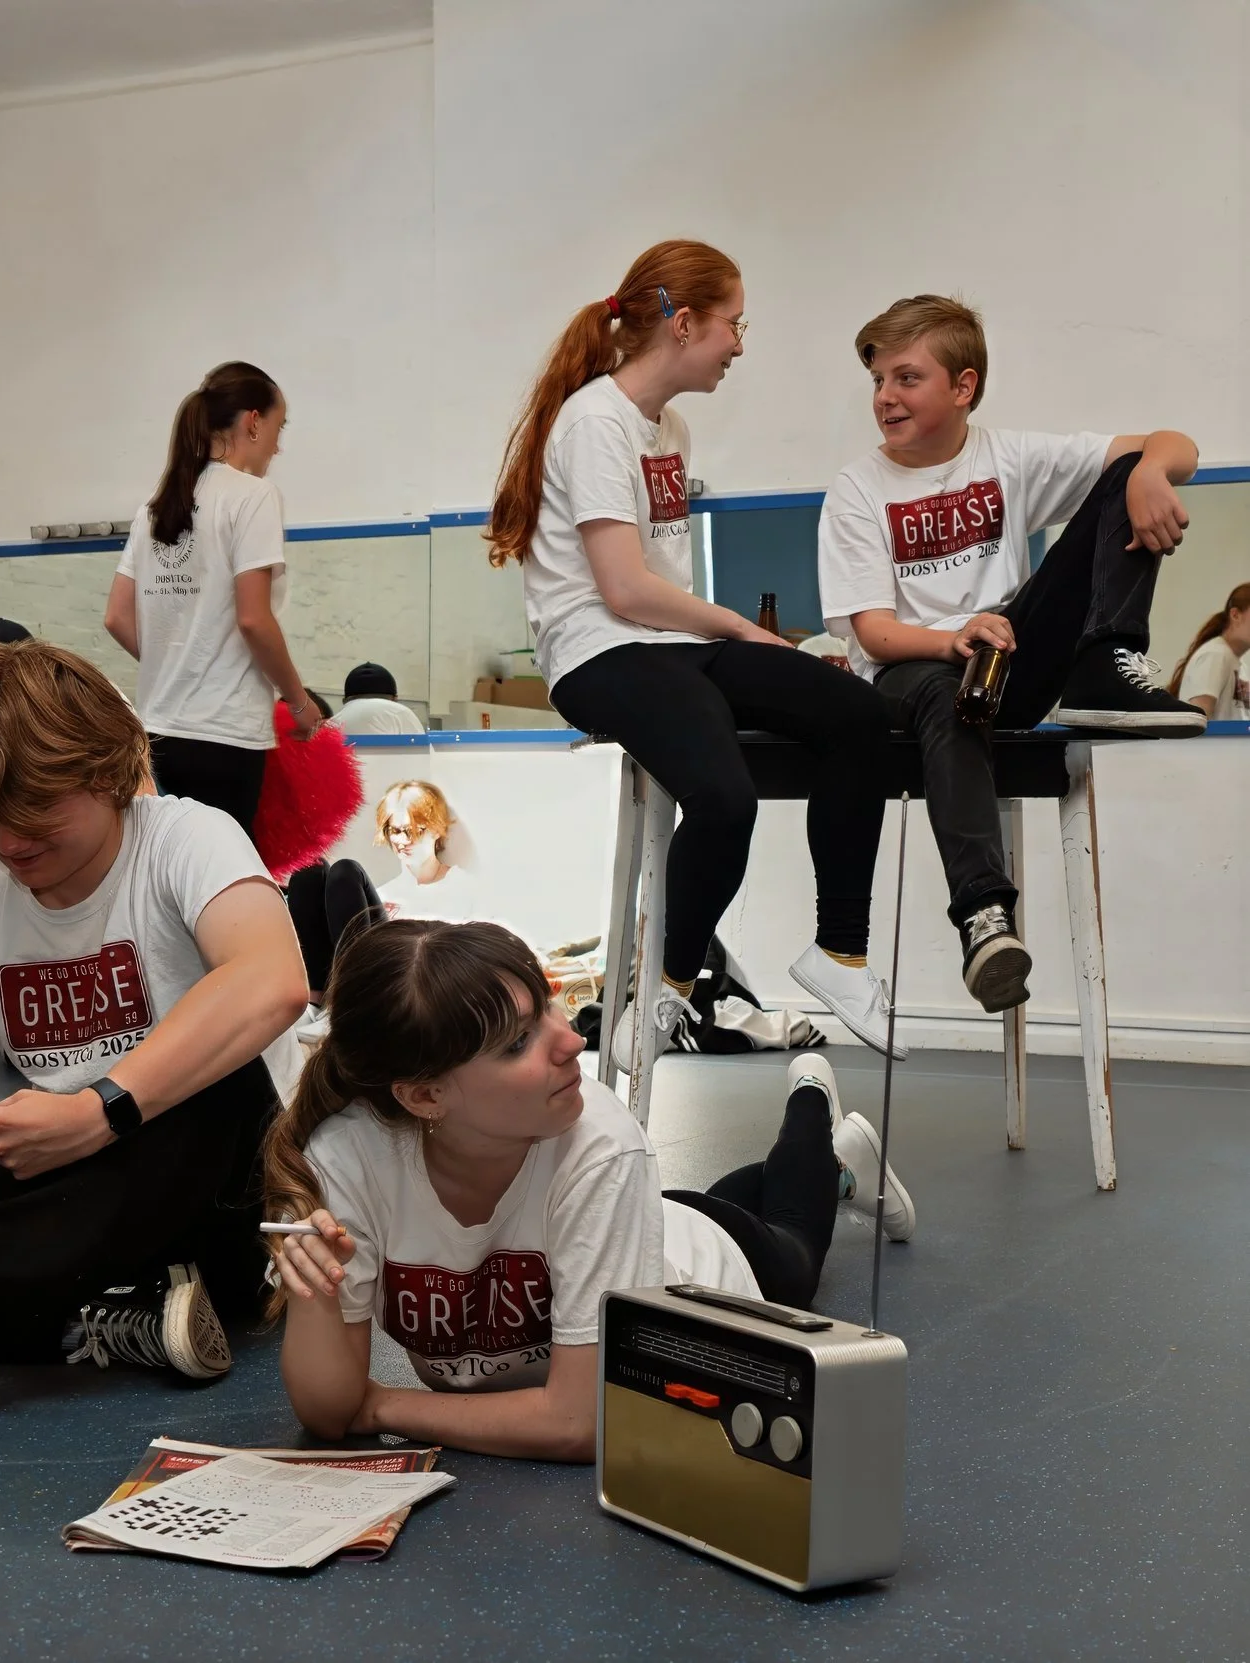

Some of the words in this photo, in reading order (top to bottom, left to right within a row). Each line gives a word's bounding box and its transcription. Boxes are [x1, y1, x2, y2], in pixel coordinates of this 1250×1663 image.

[902, 494, 1000, 544] GREASE
[942, 530, 986, 552] MUSICAL
[899, 554, 971, 578] DOSYTCo
[38, 968, 53, 980] WE
[56, 968, 68, 979] GO
[26, 1032, 36, 1044] 19
[46, 1029, 70, 1042] THE
[125, 1011, 138, 1024] 59
[18, 1046, 92, 1068] DOSYTCo
[424, 1274, 442, 1288] WE
[450, 1279, 465, 1292] GO
[427, 1342, 458, 1352] THE
[430, 1358, 510, 1376] SYTCo
[520, 1342, 550, 1364] 20
